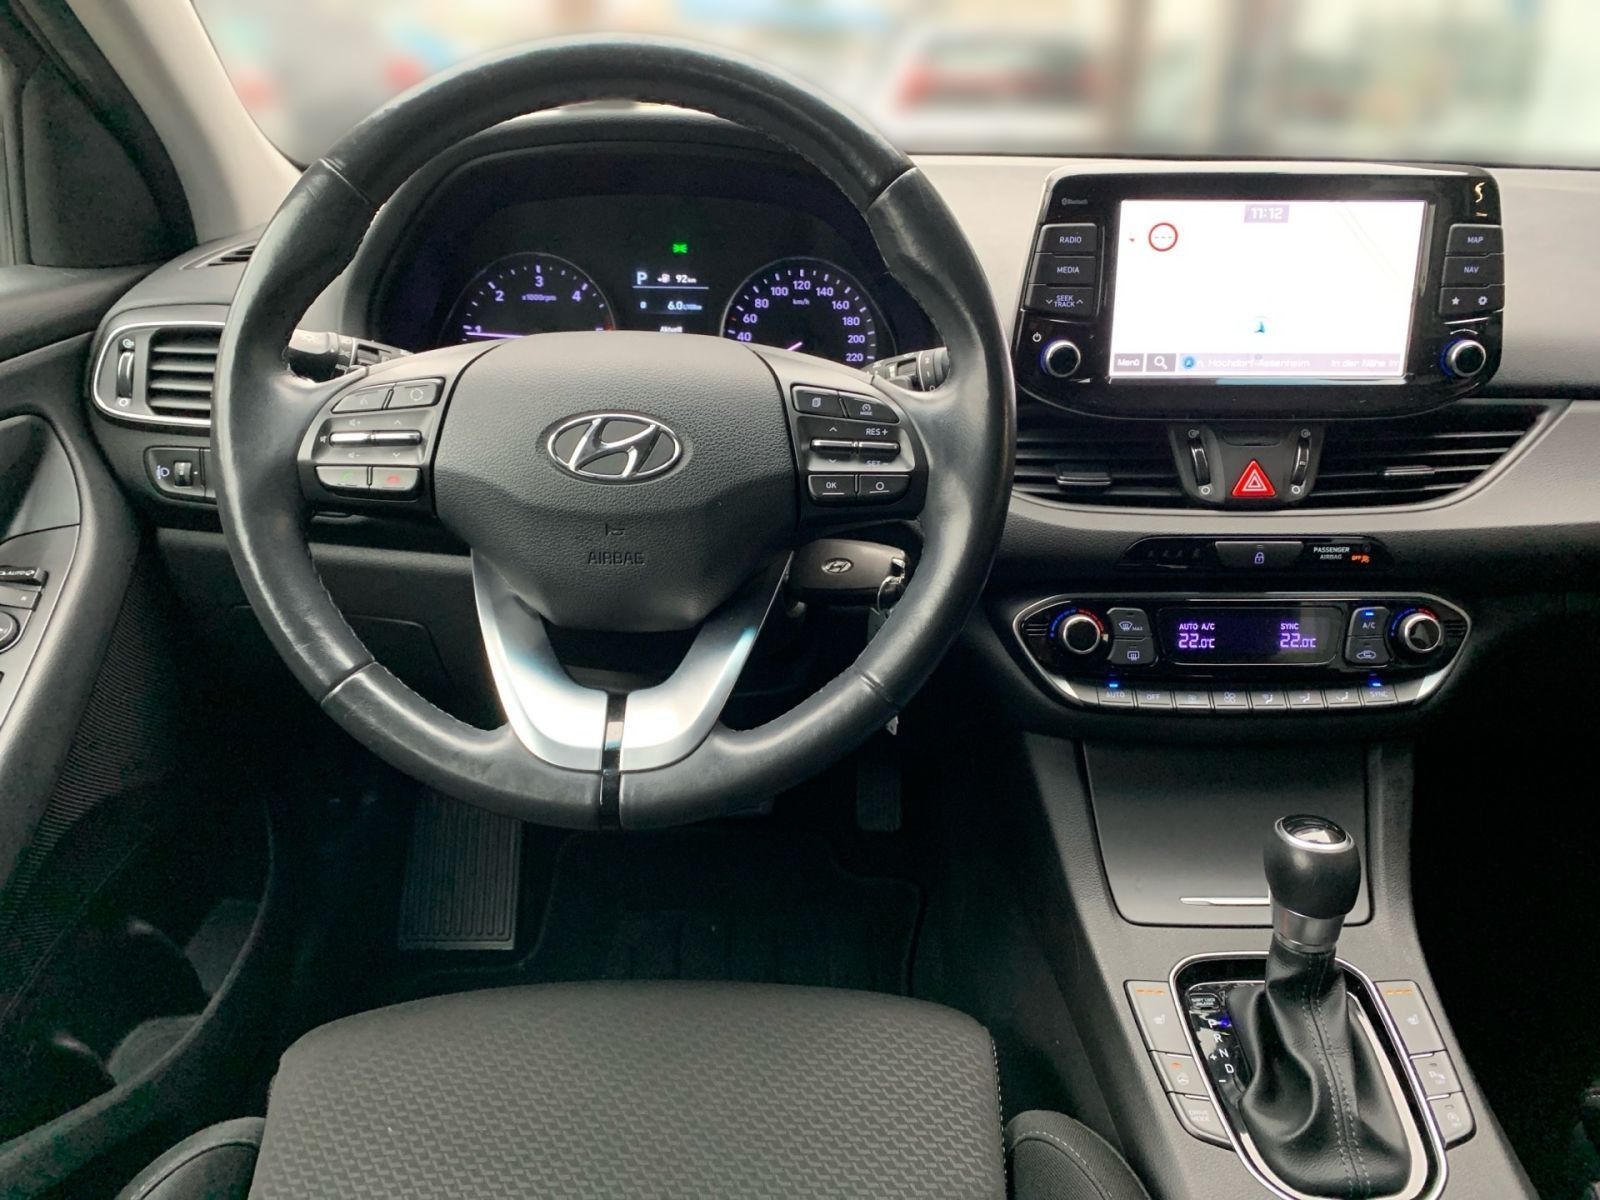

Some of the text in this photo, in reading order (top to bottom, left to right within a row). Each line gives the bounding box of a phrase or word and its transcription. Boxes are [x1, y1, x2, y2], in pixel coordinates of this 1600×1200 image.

[1251, 207, 1283, 220] 11:12
[1059, 236, 1082, 244] RADIO
[535, 276, 544, 287] 3
[637, 271, 648, 285] P
[793, 280, 811, 290] 120
[495, 290, 504, 302] 2
[572, 290, 581, 302] 4
[770, 286, 789, 296] 100
[816, 287, 834, 296] 140
[754, 298, 769, 309] 80
[792, 298, 810, 306] km/h
[832, 300, 850, 310] 160
[742, 313, 758, 324] 60
[842, 316, 860, 326] 180
[737, 331, 752, 341] 40
[847, 334, 865, 344] 200
[846, 352, 864, 362] 220
[587, 551, 645, 565] AIRBAG
[1208, 1019, 1217, 1028] P
[1214, 1033, 1223, 1043] R
[1219, 1048, 1229, 1058] N
[1225, 1063, 1235, 1074] D
